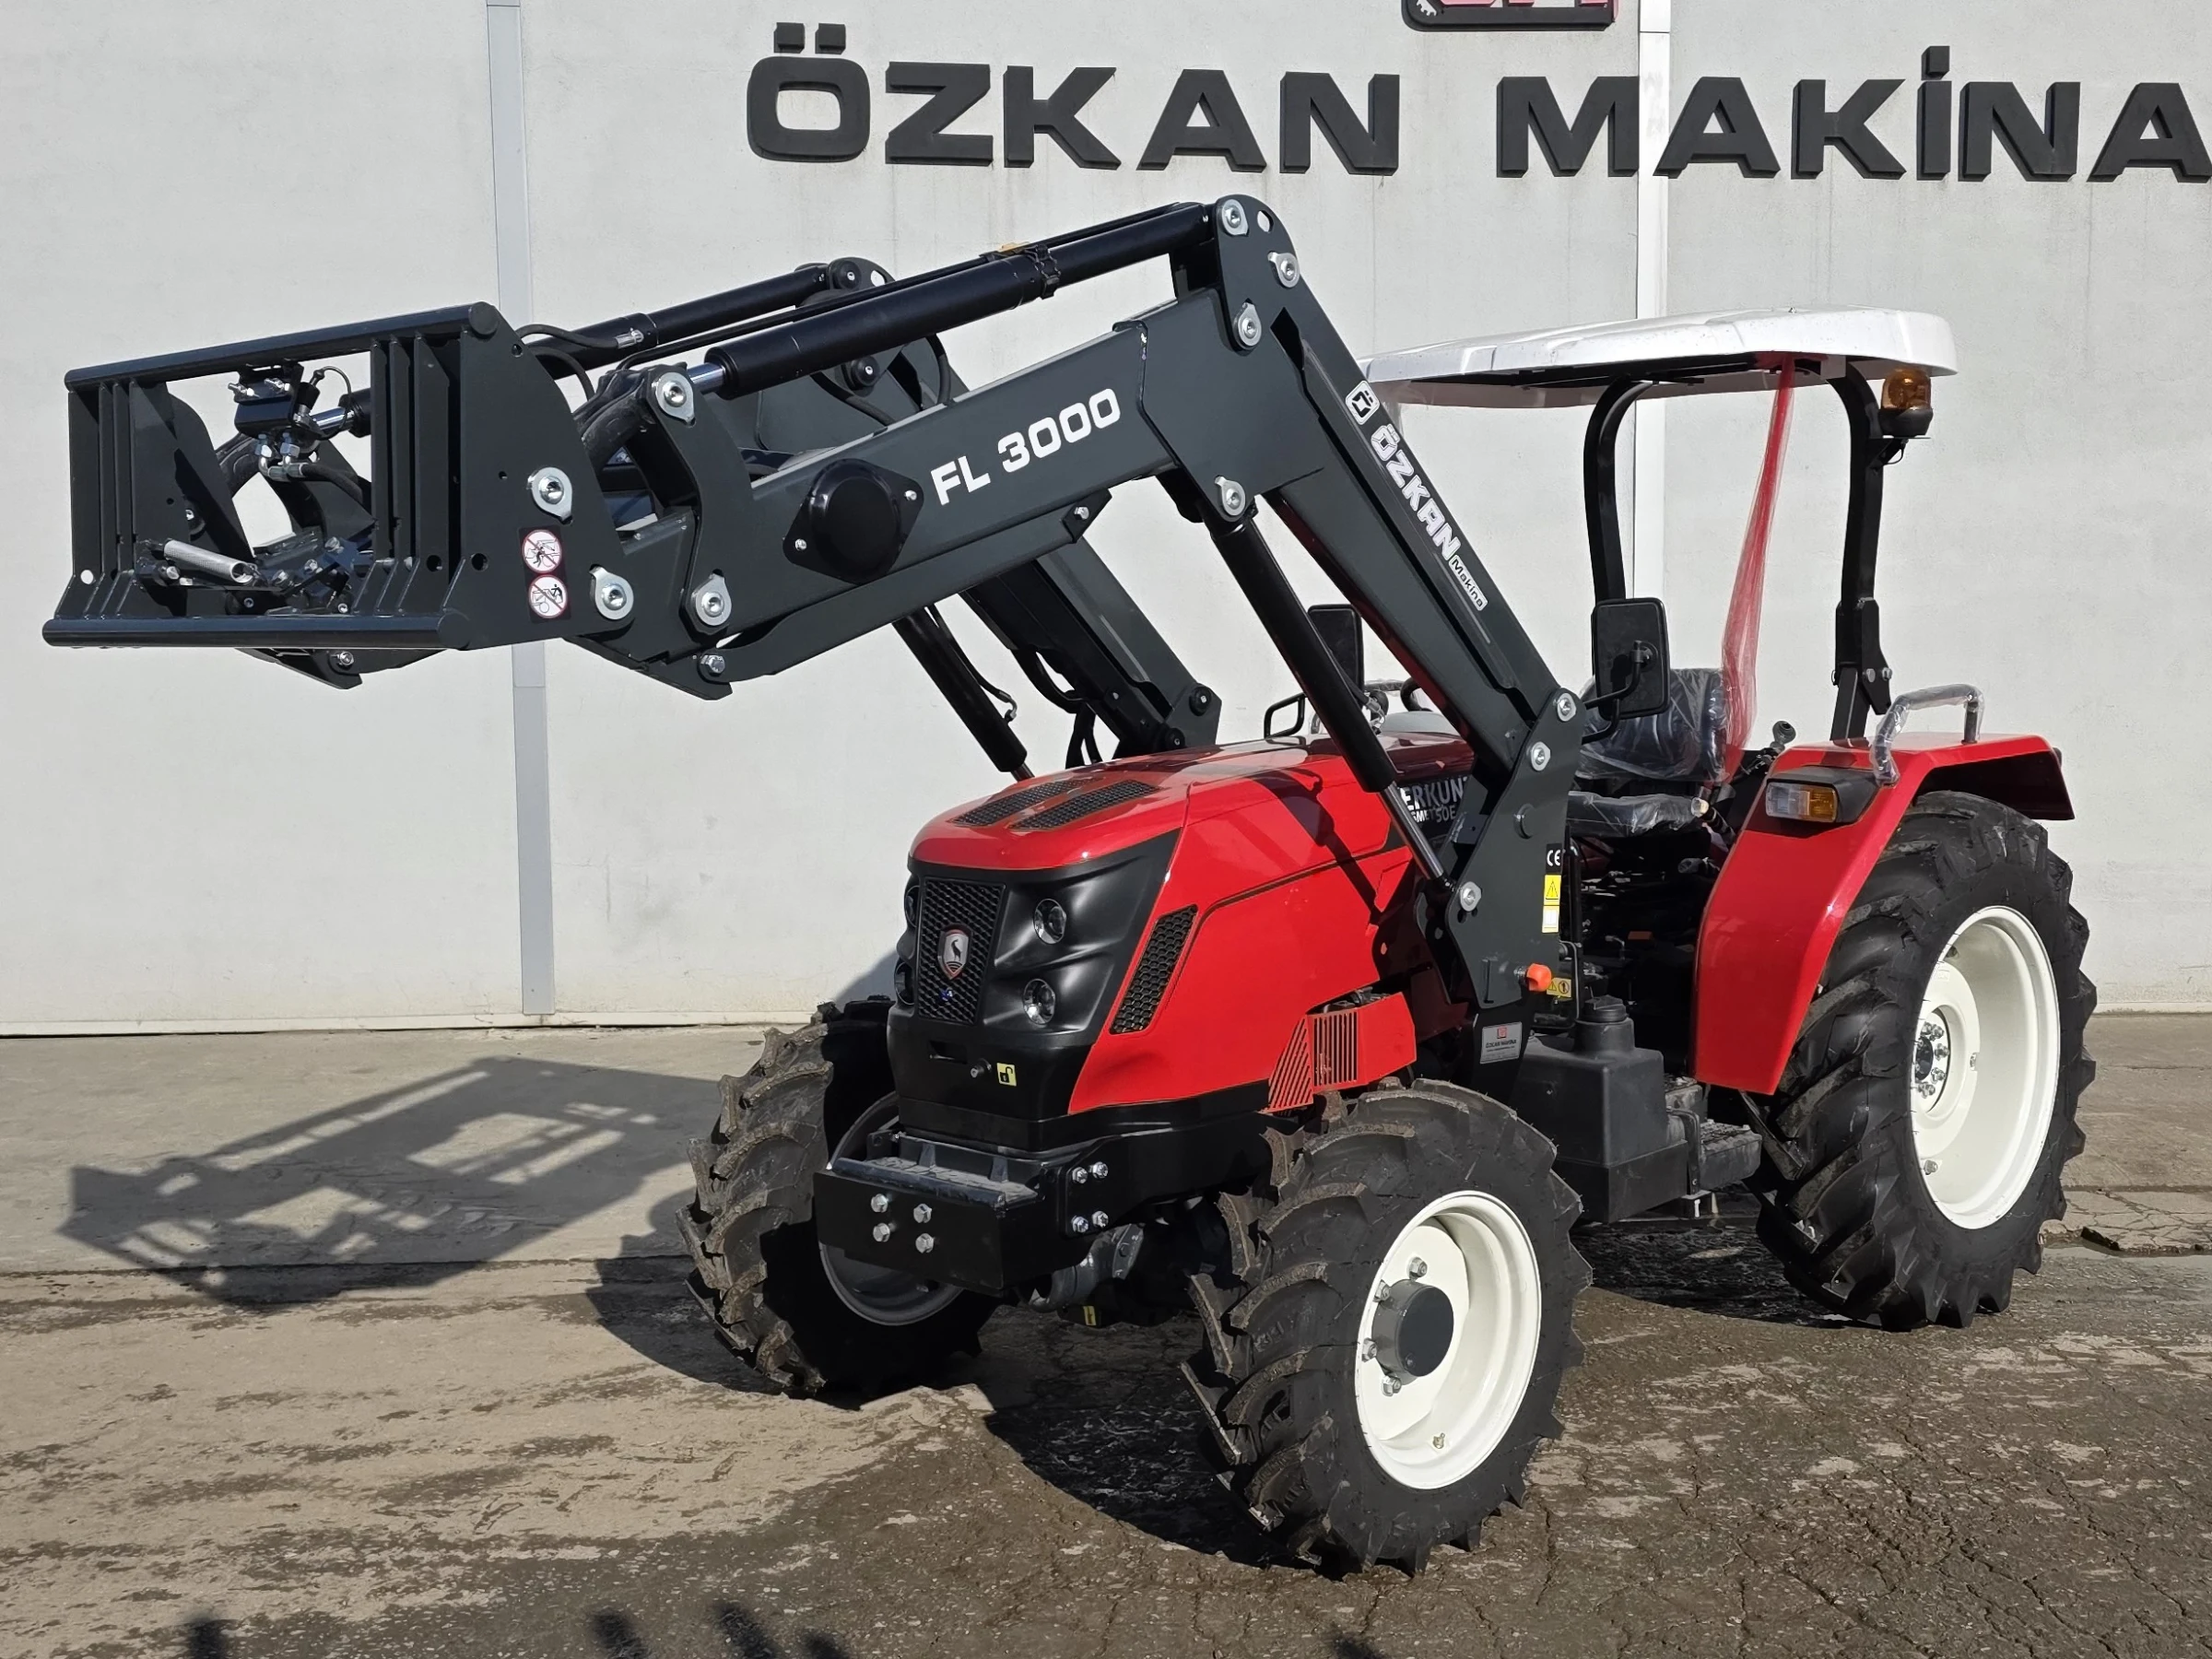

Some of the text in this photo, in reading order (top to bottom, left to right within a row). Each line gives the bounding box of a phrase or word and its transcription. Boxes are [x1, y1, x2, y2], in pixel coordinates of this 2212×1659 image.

[747, 22, 2212, 182] ÖZKAN MAKİNA
[930, 388, 1121, 506] FL 3000
[1371, 423, 1483, 607] ÖZKAN Makina
[1400, 776, 1467, 811] ERKUN
[1547, 849, 1561, 866] CE
